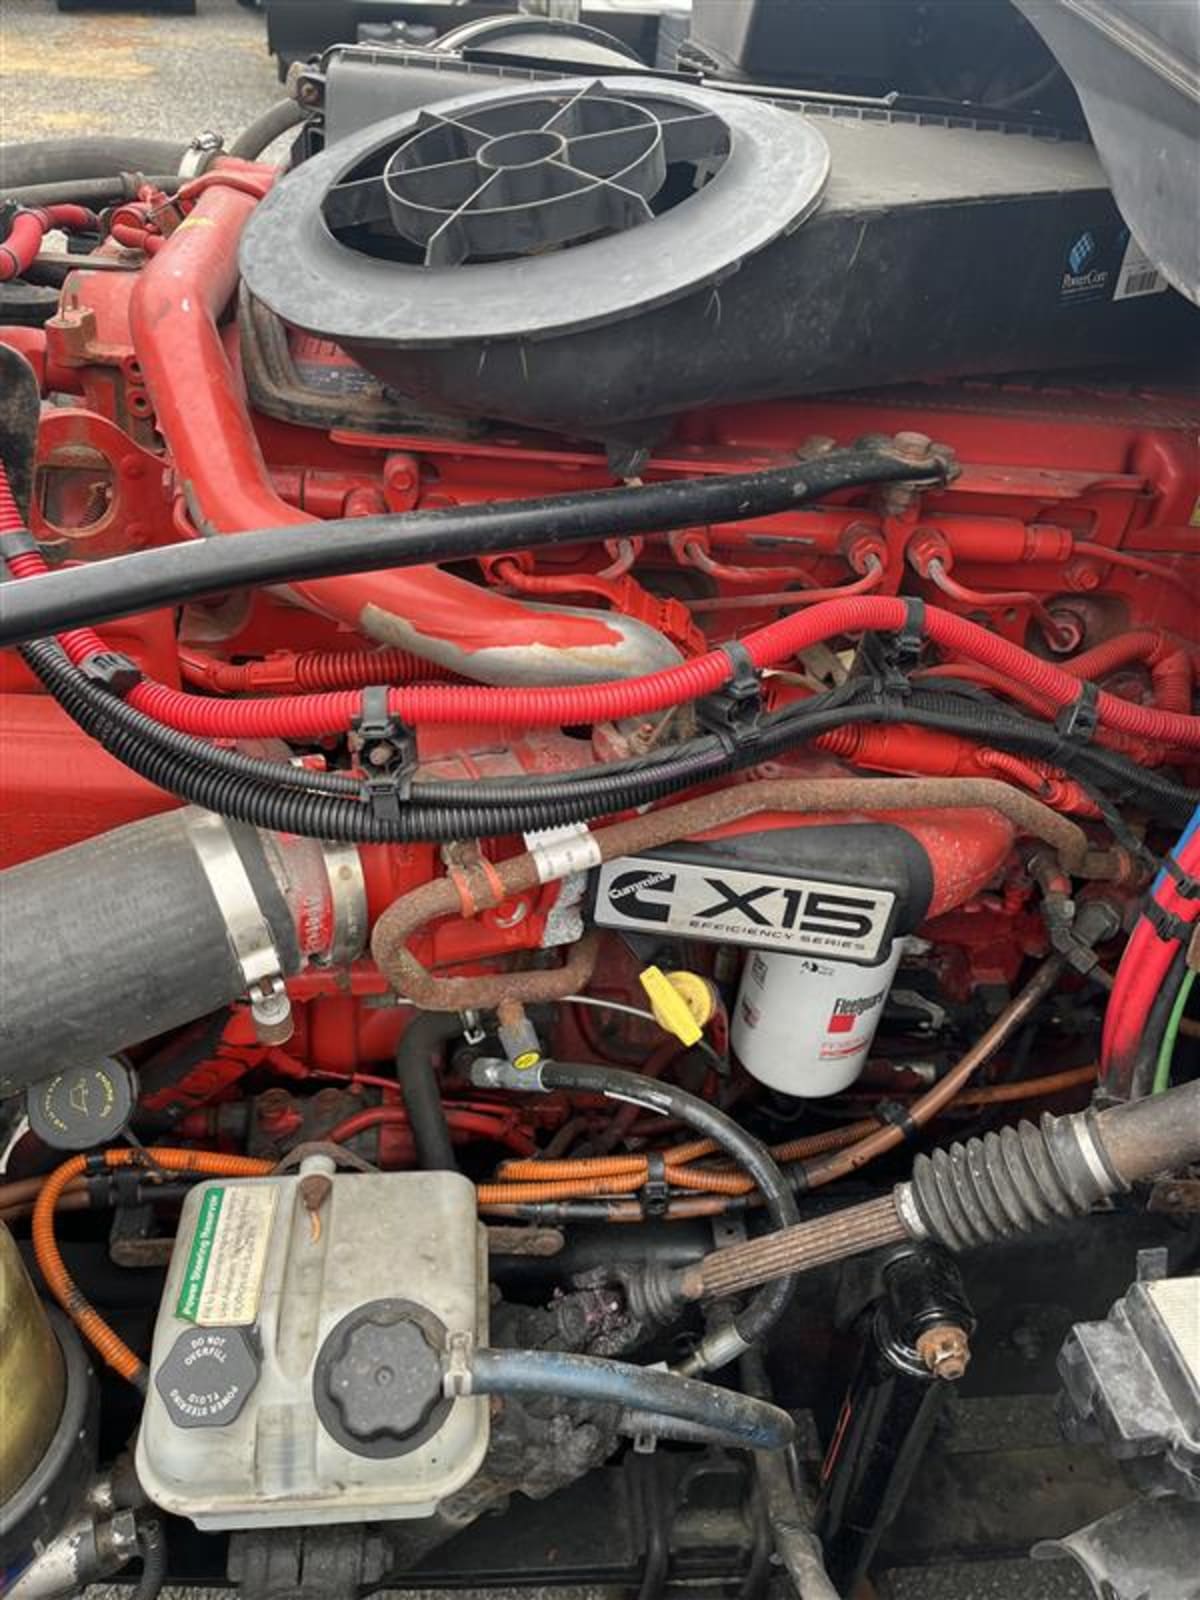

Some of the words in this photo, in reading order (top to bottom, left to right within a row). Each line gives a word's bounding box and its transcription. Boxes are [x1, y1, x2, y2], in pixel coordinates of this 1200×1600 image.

[608, 872, 671, 900] Cummins
[692, 877, 876, 938] X15
[689, 919, 795, 940] EFFICIENCY
[800, 934, 867, 951] SERIES
[183, 1346, 227, 1366] OVERFILL
[191, 1337, 205, 1349] DO
[168, 1387, 208, 1417] STEERING
[209, 1384, 240, 1415] POWER
